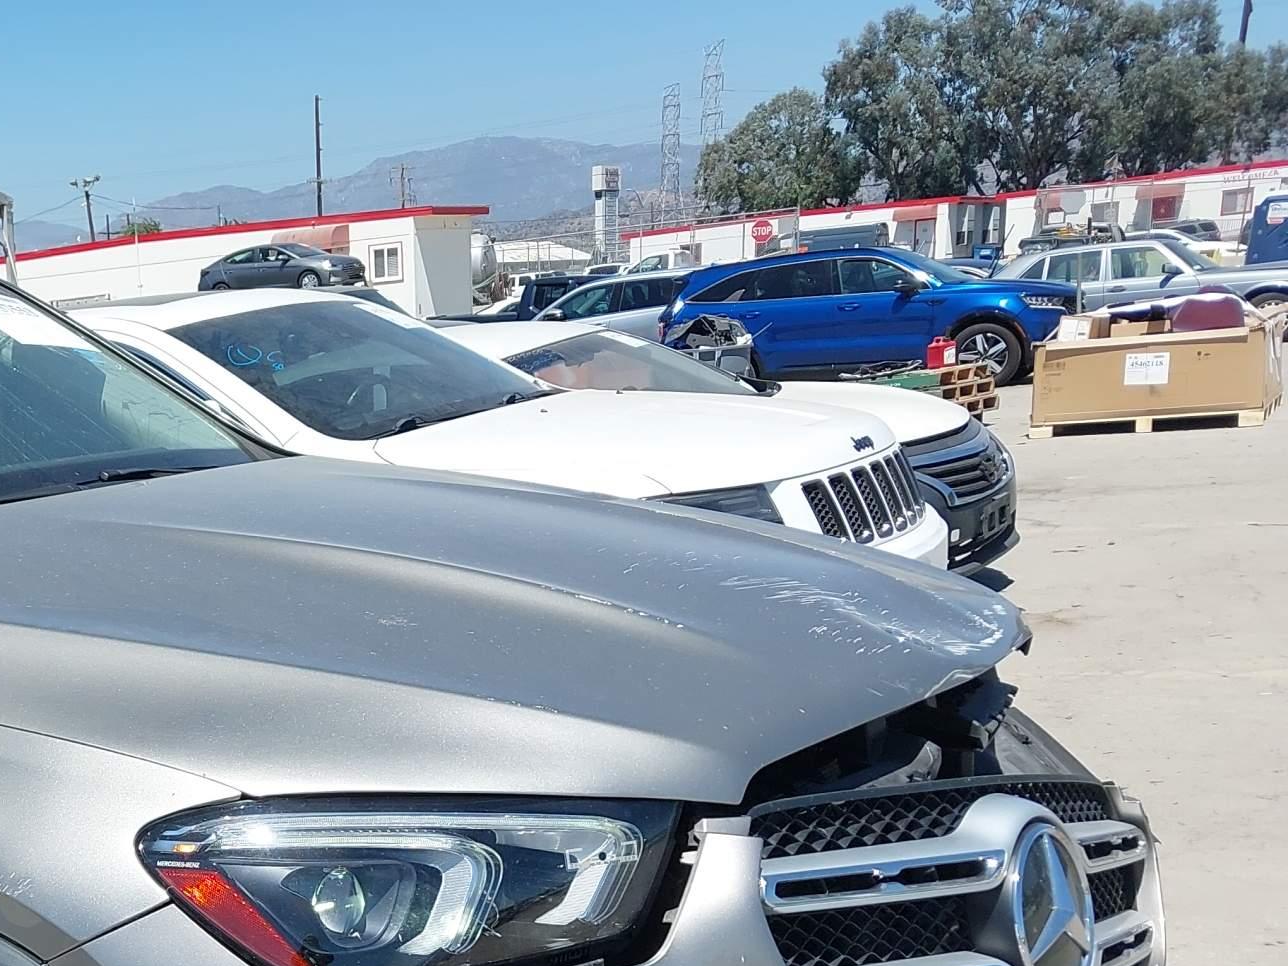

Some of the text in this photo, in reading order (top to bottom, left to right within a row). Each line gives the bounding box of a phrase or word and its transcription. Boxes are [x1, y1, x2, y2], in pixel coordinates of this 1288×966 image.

[752, 226, 772, 236] STOP
[850, 435, 875, 452] Jeep
[157, 860, 200, 869] MERCEDES-BENZ
